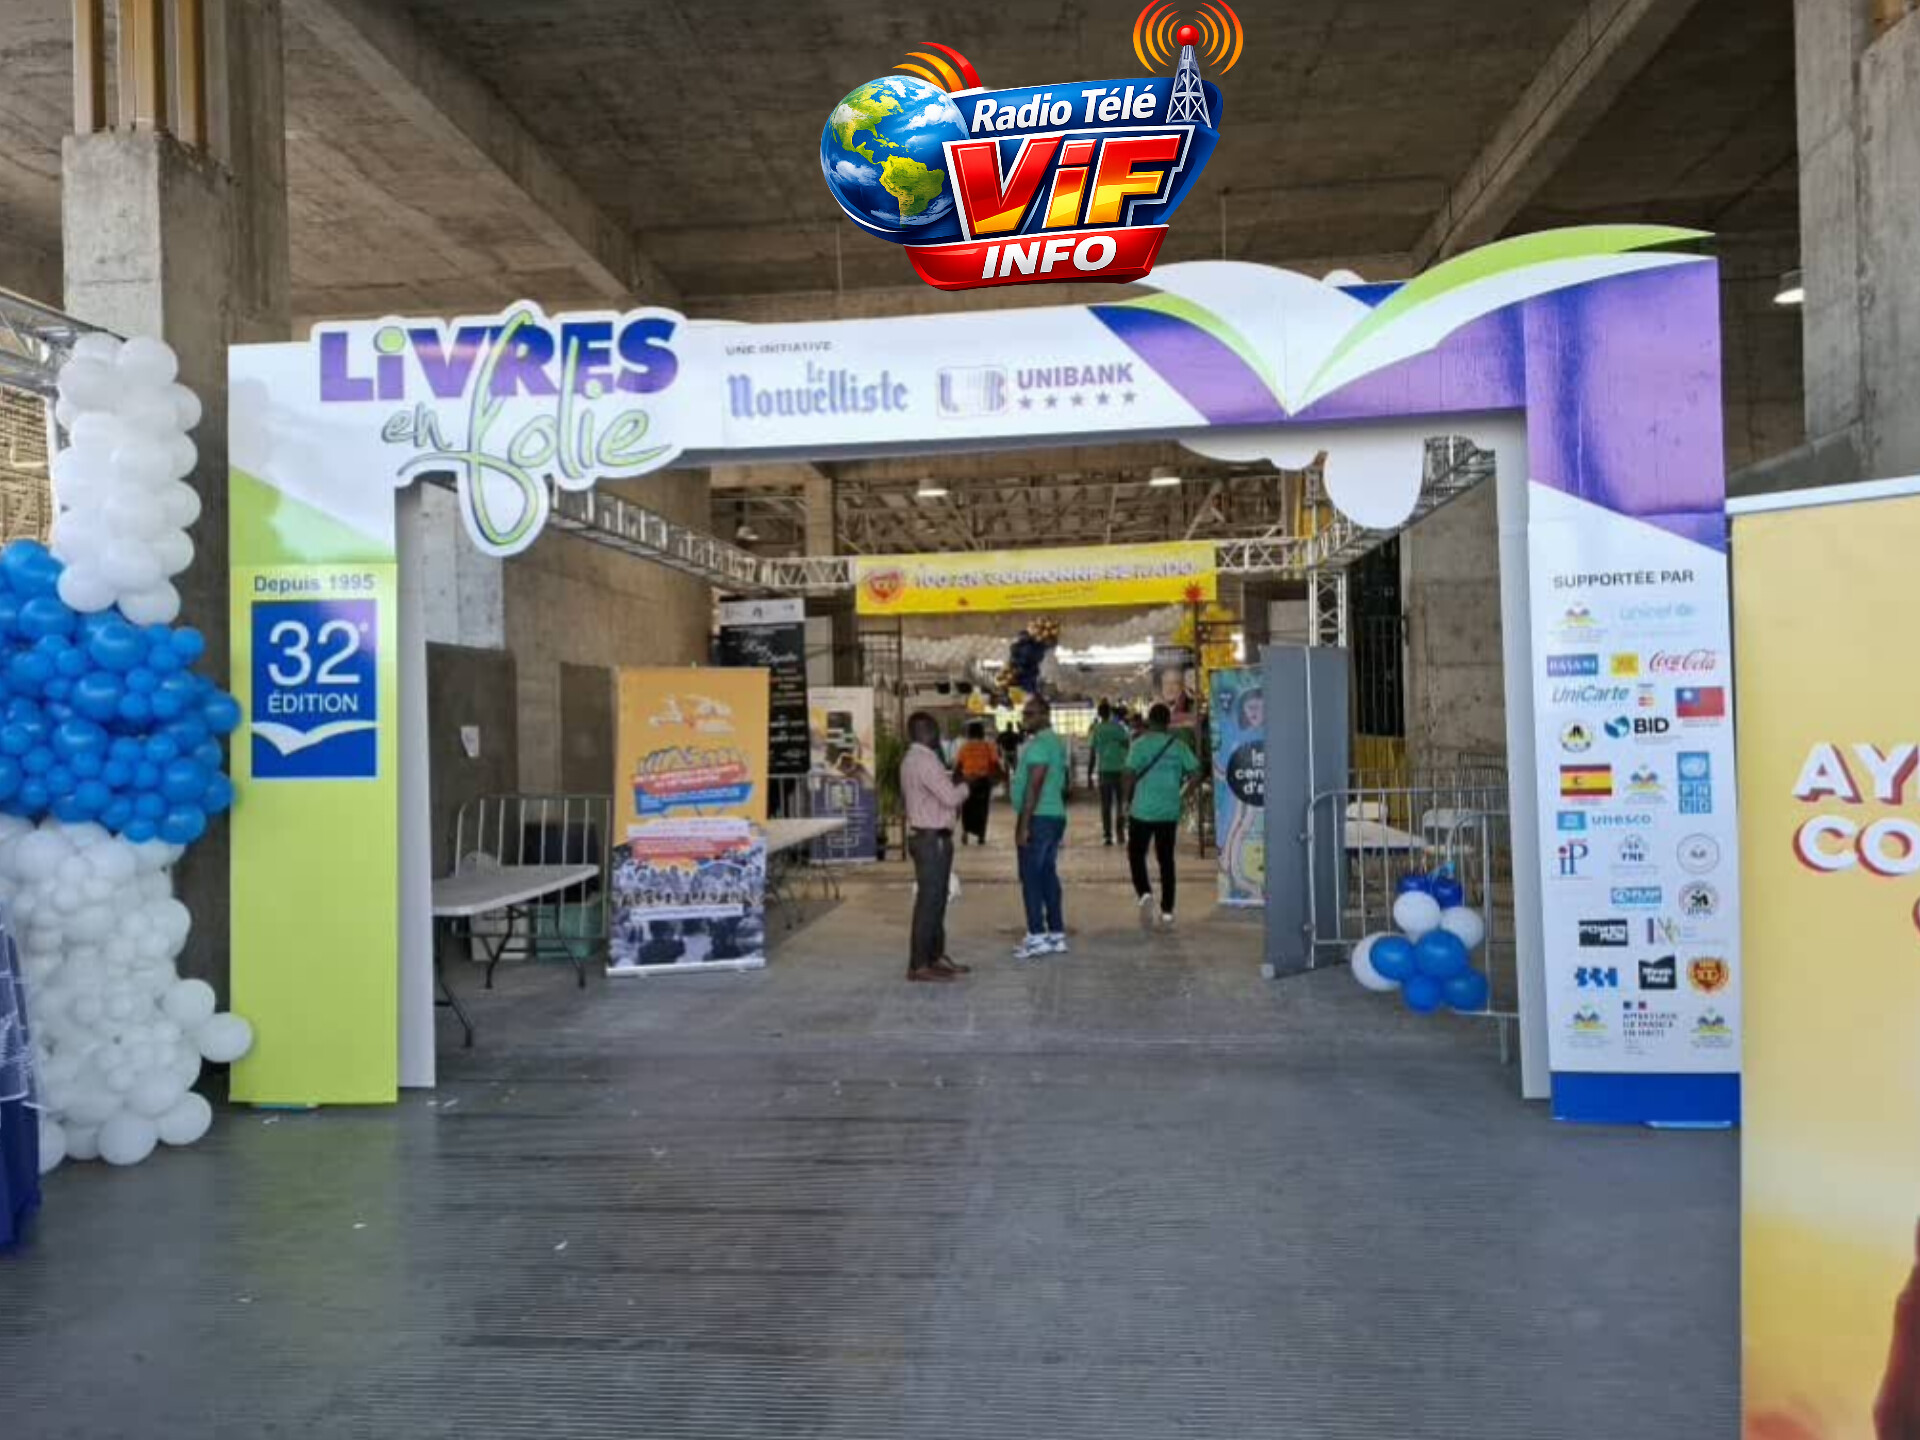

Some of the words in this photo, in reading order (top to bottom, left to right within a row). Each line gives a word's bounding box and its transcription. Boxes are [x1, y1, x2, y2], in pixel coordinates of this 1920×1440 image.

[725, 344, 756, 356] UNE
[1017, 363, 1134, 390] UNIBANK
[727, 368, 909, 418] Nouvelliste
[382, 403, 453, 448] en
[398, 309, 673, 546] folie
[254, 575, 321, 594] Depuis
[329, 574, 375, 591] 1995
[1661, 569, 1694, 583] PAR
[268, 690, 358, 713] ÉDITION
[1552, 683, 1630, 704] UniCarte
[1634, 717, 1669, 734] BID
[1792, 742, 1920, 804] AY
[1592, 813, 1651, 825] unesco
